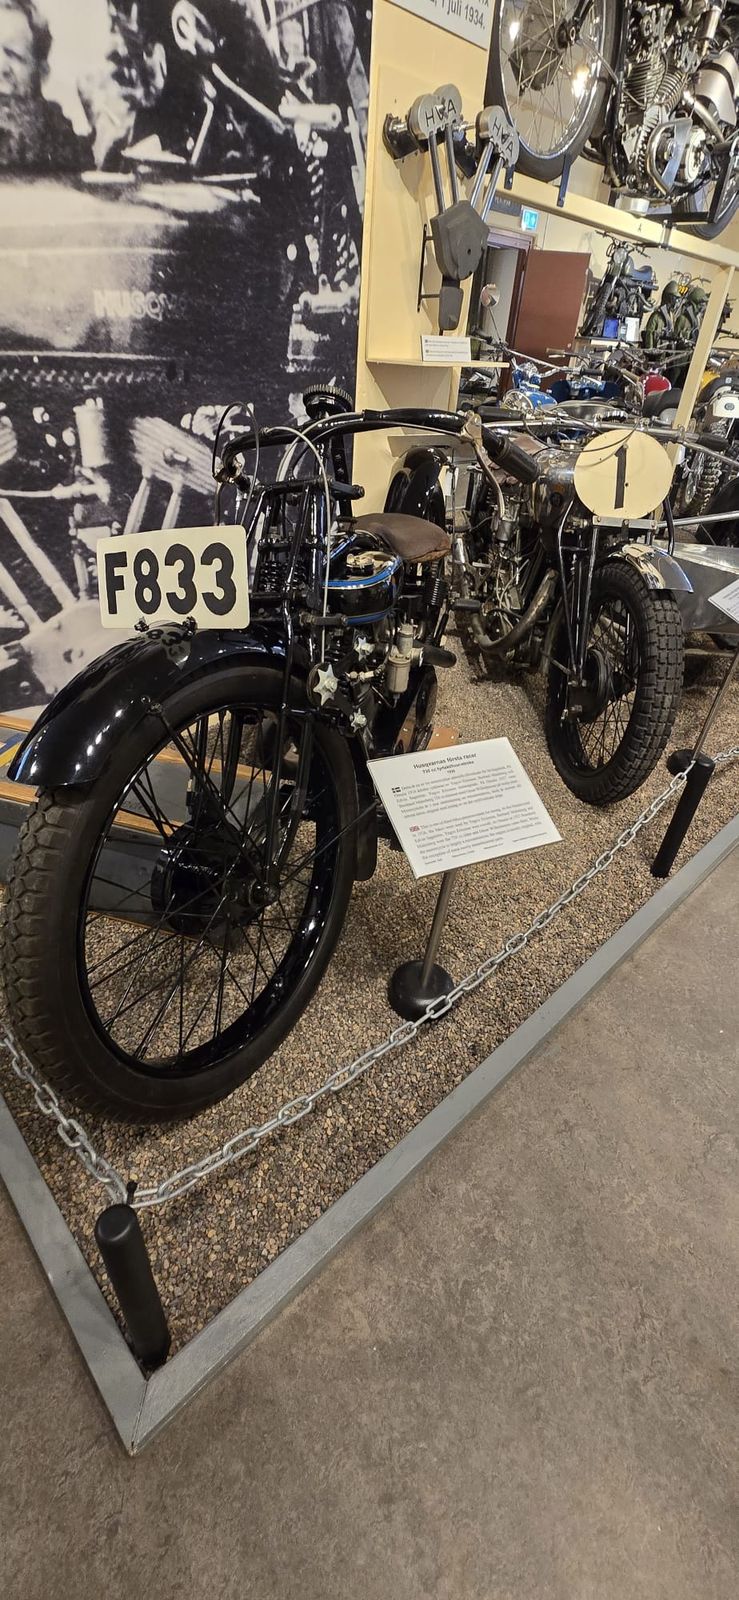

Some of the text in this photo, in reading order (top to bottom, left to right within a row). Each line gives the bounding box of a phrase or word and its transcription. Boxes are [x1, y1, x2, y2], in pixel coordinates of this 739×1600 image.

[447, 0, 462, 17] juli
[465, 5, 485, 30] 1934.
[614, 444, 628, 510] 1
[104, 542, 237, 616] F833
